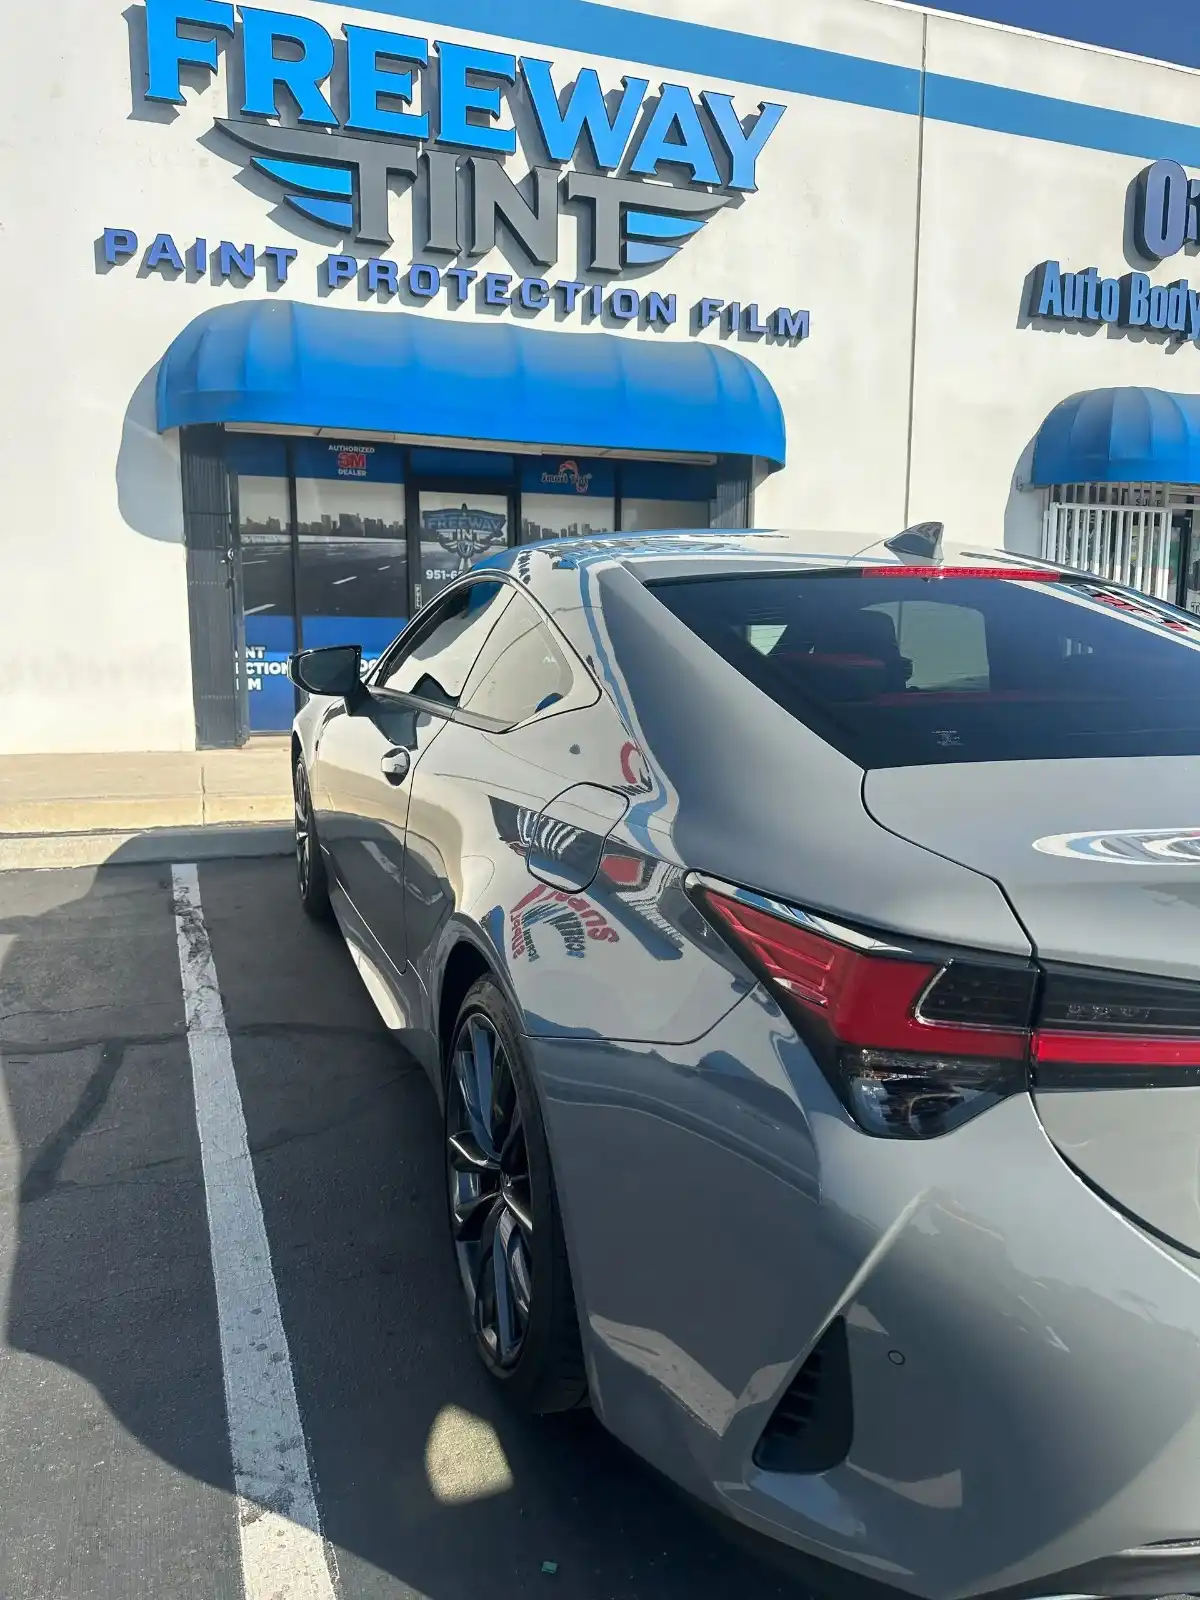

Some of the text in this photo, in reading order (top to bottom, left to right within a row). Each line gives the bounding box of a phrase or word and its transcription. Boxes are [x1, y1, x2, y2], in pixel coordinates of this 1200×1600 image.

[144, 0, 787, 194] FREEWAY
[103, 227, 811, 339] PAINT PROTECTION FILM
[1037, 260, 1120, 322] Auto
[328, 444, 375, 454] AUTHORIZED
[337, 452, 367, 470] 3M
[337, 468, 367, 477] DEALER
[428, 515, 500, 530] FREEWAY
[437, 528, 490, 541] TINT
